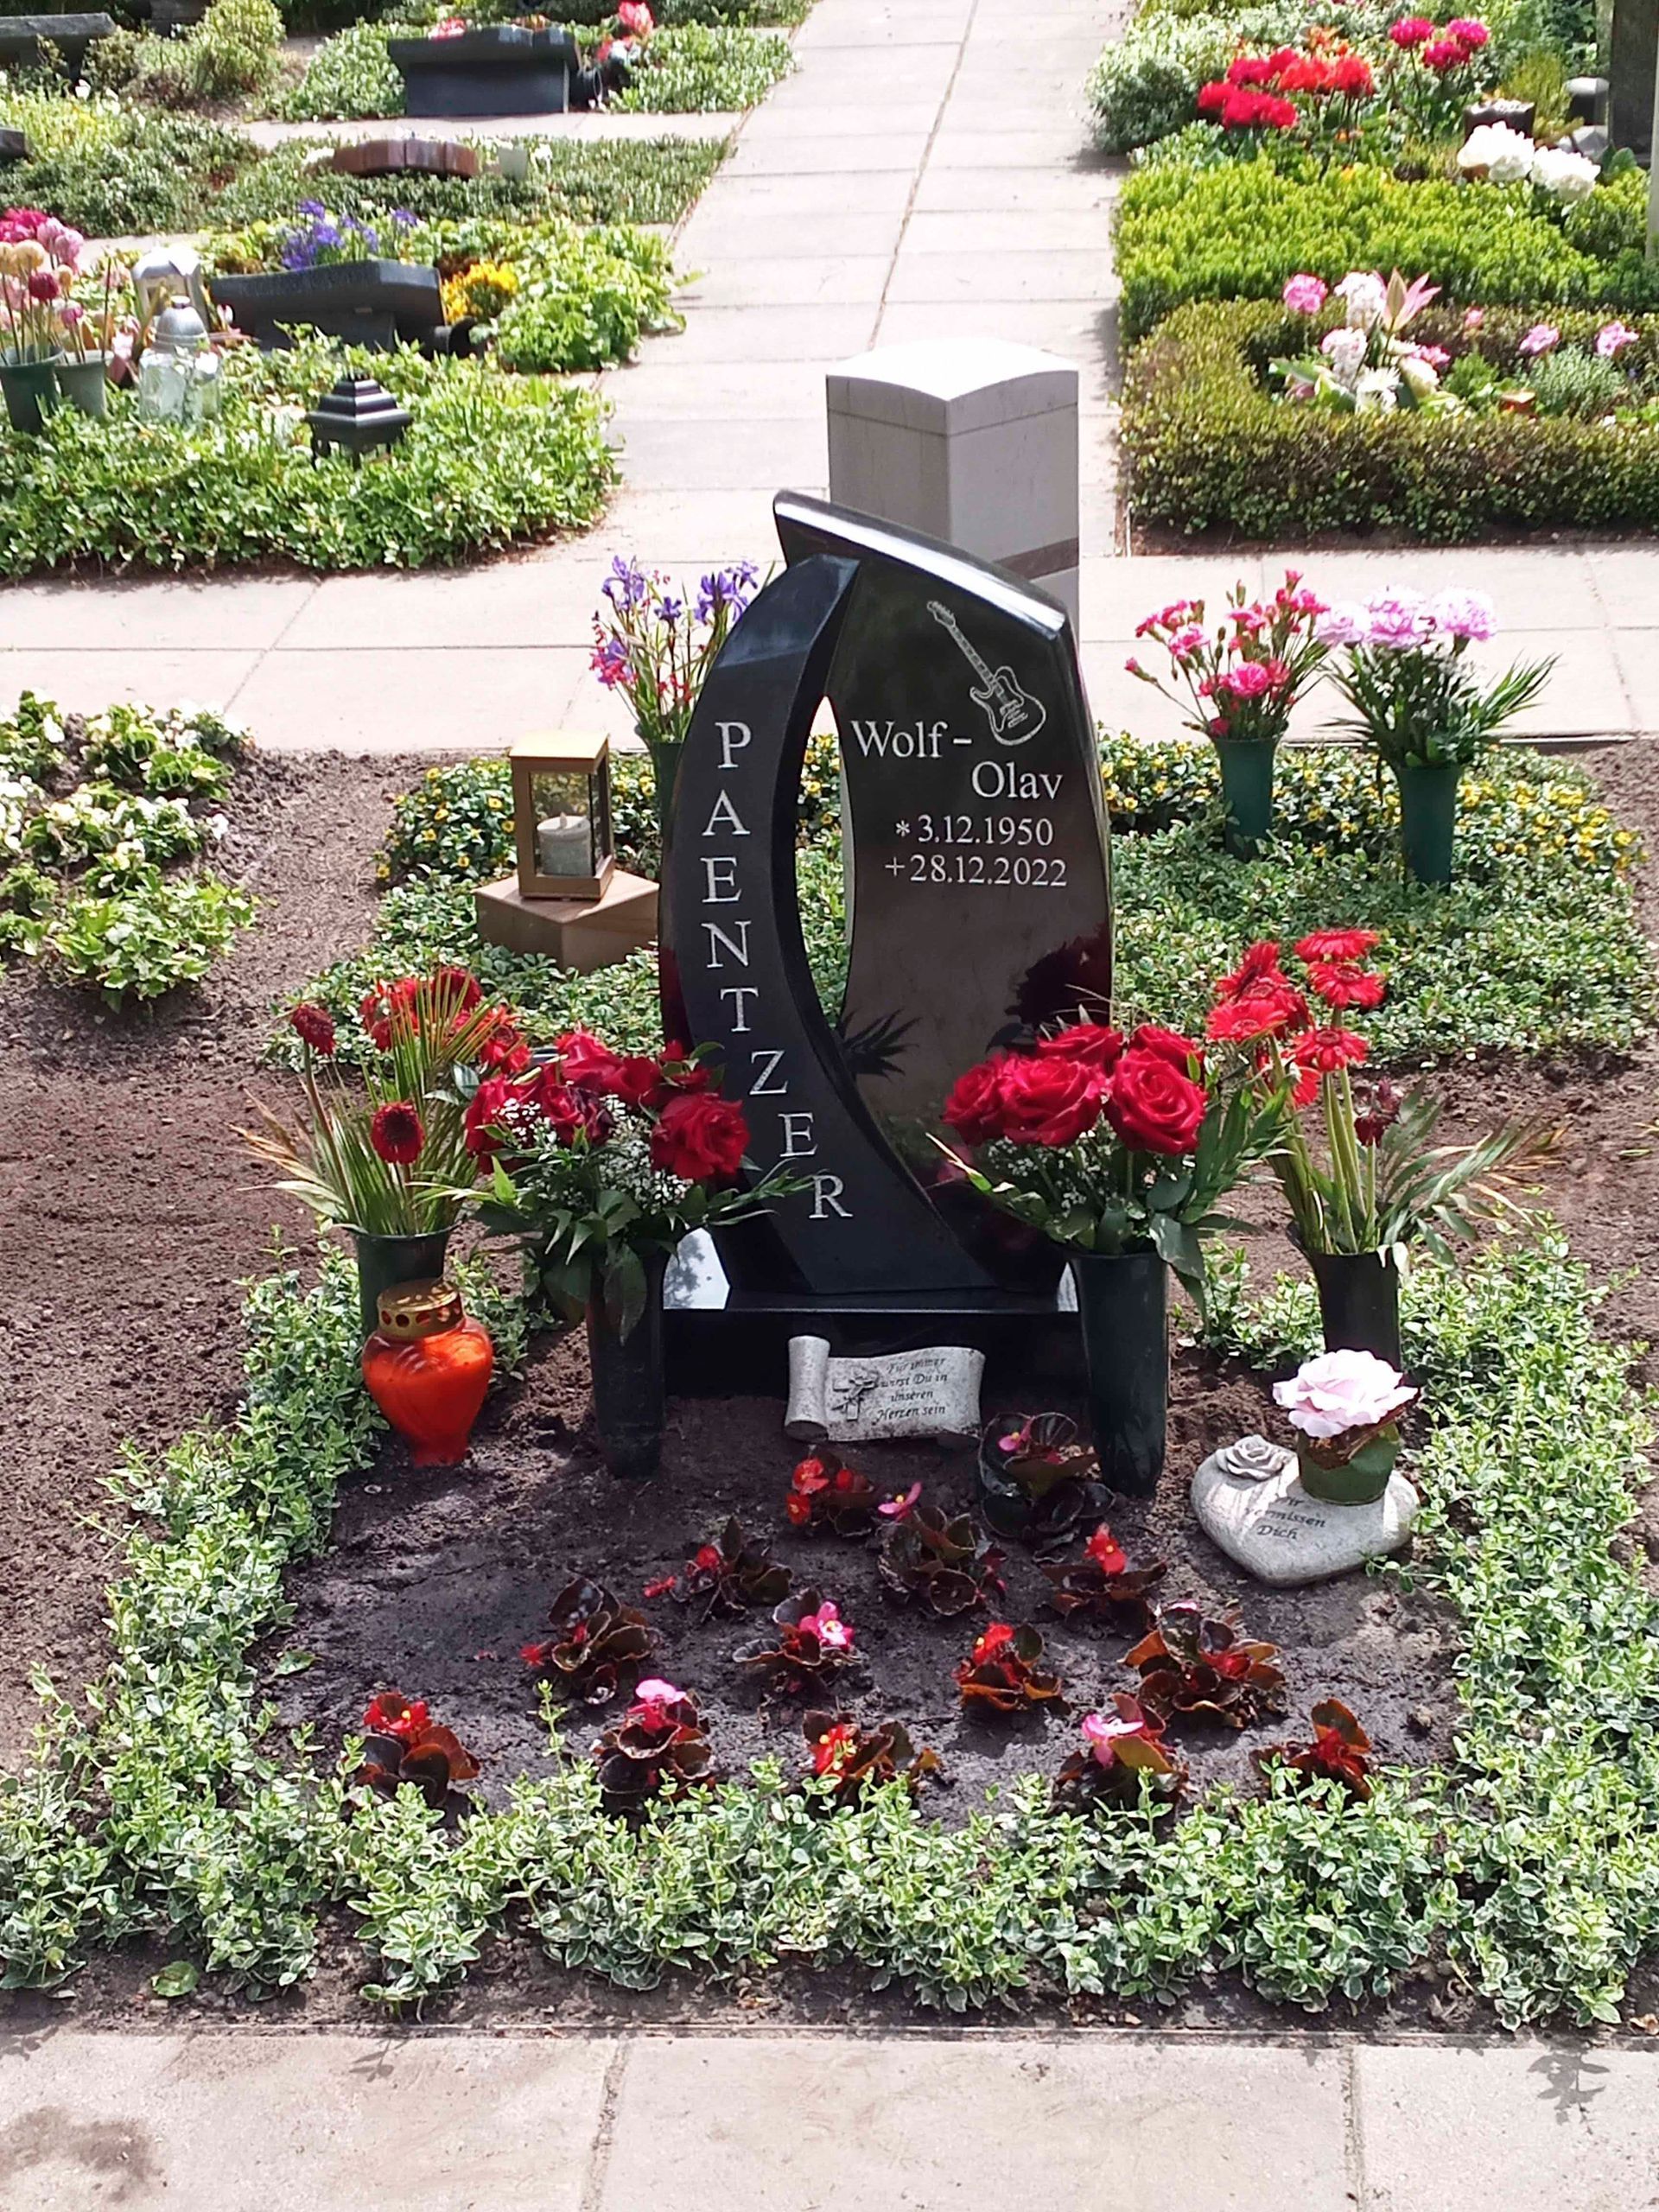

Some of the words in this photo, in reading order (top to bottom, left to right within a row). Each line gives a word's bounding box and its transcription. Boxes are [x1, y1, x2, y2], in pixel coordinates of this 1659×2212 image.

[971, 760, 1063, 799] Olav
[702, 721, 854, 1219] PAENTZER
[912, 1372, 933, 1385] Du
[935, 1374, 948, 1382] in
[891, 1390, 933, 1402] unseren
[875, 1407, 919, 1421] Herzen
[922, 1406, 946, 1416] sein
[1257, 1524, 1299, 1540] Dich
